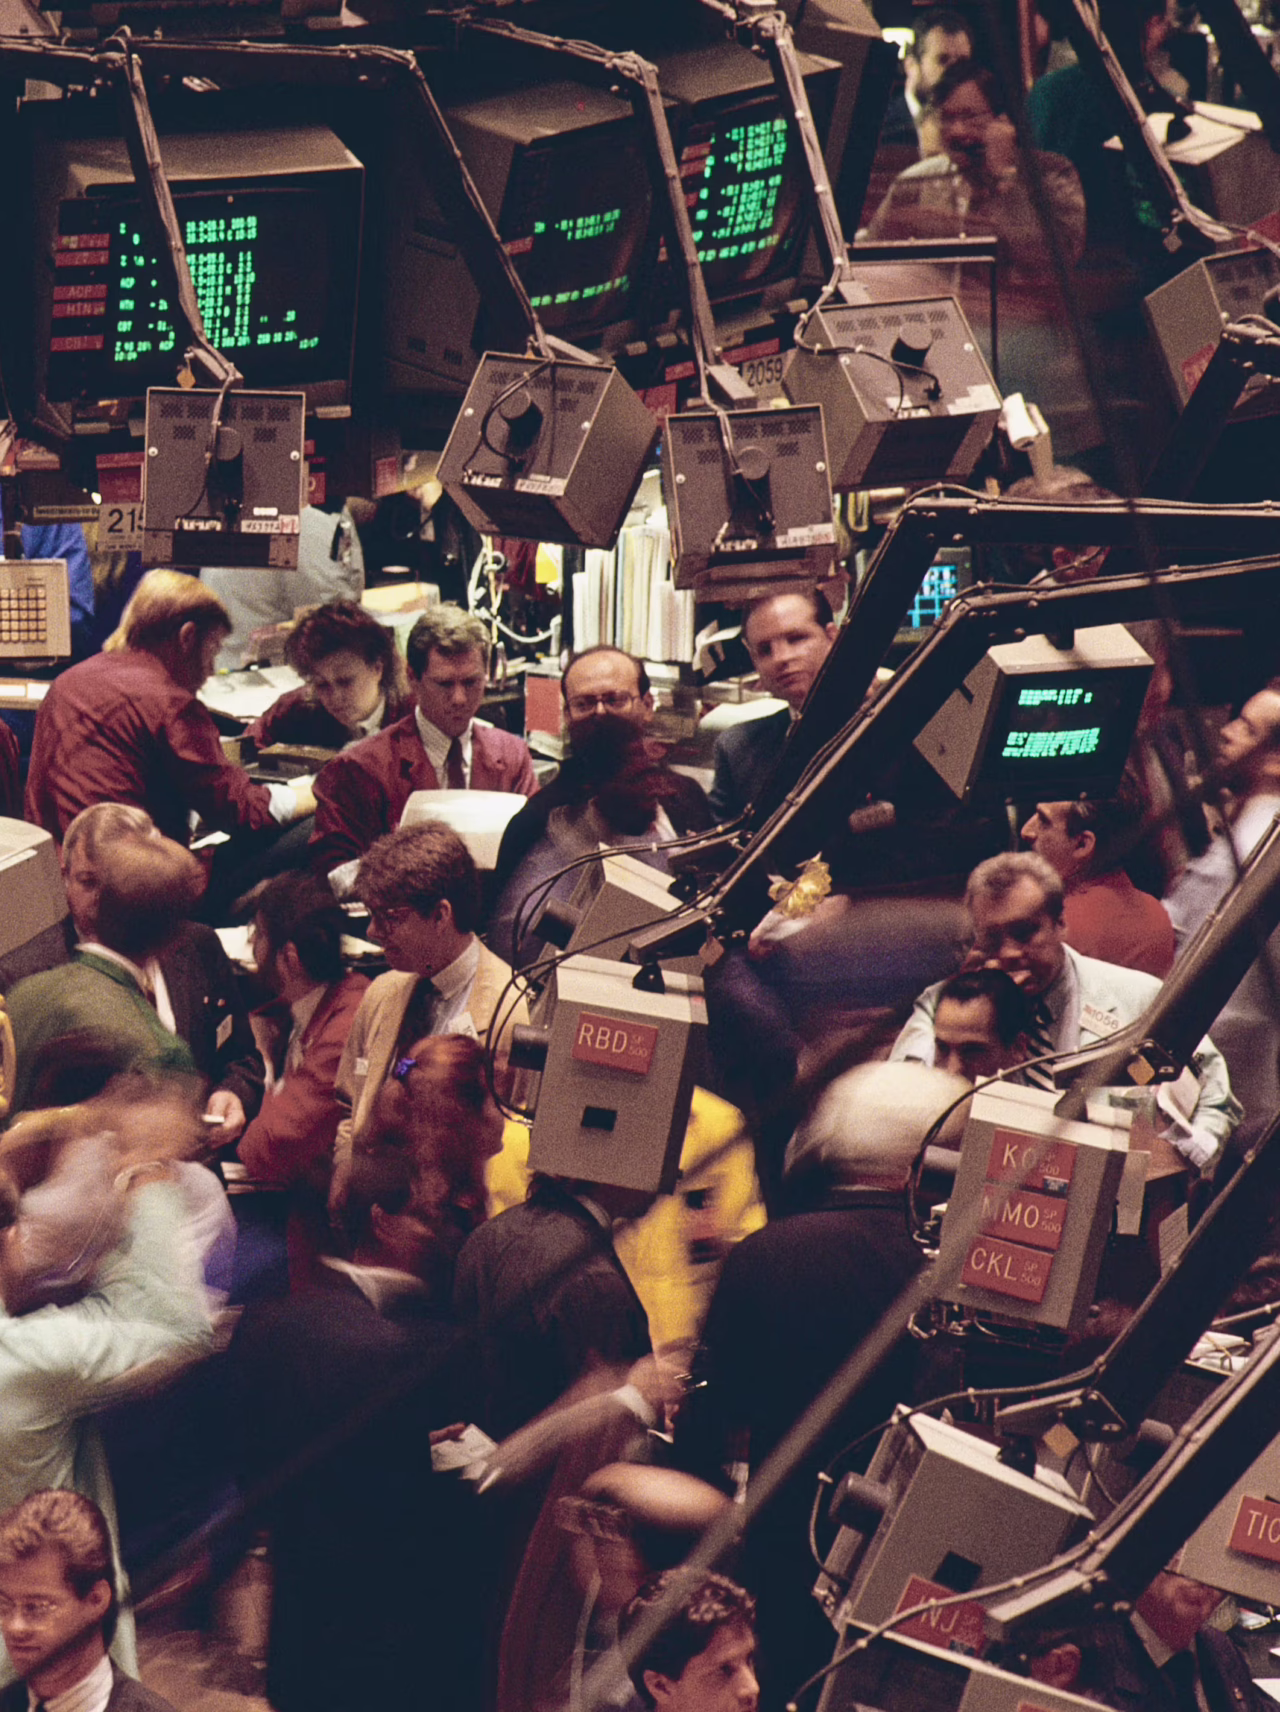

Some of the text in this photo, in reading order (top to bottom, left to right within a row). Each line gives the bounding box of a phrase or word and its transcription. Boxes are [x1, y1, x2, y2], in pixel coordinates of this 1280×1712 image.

[747, 358, 783, 388] 2059
[578, 1023, 628, 1053] RBD
[971, 1247, 1017, 1282] CKL
